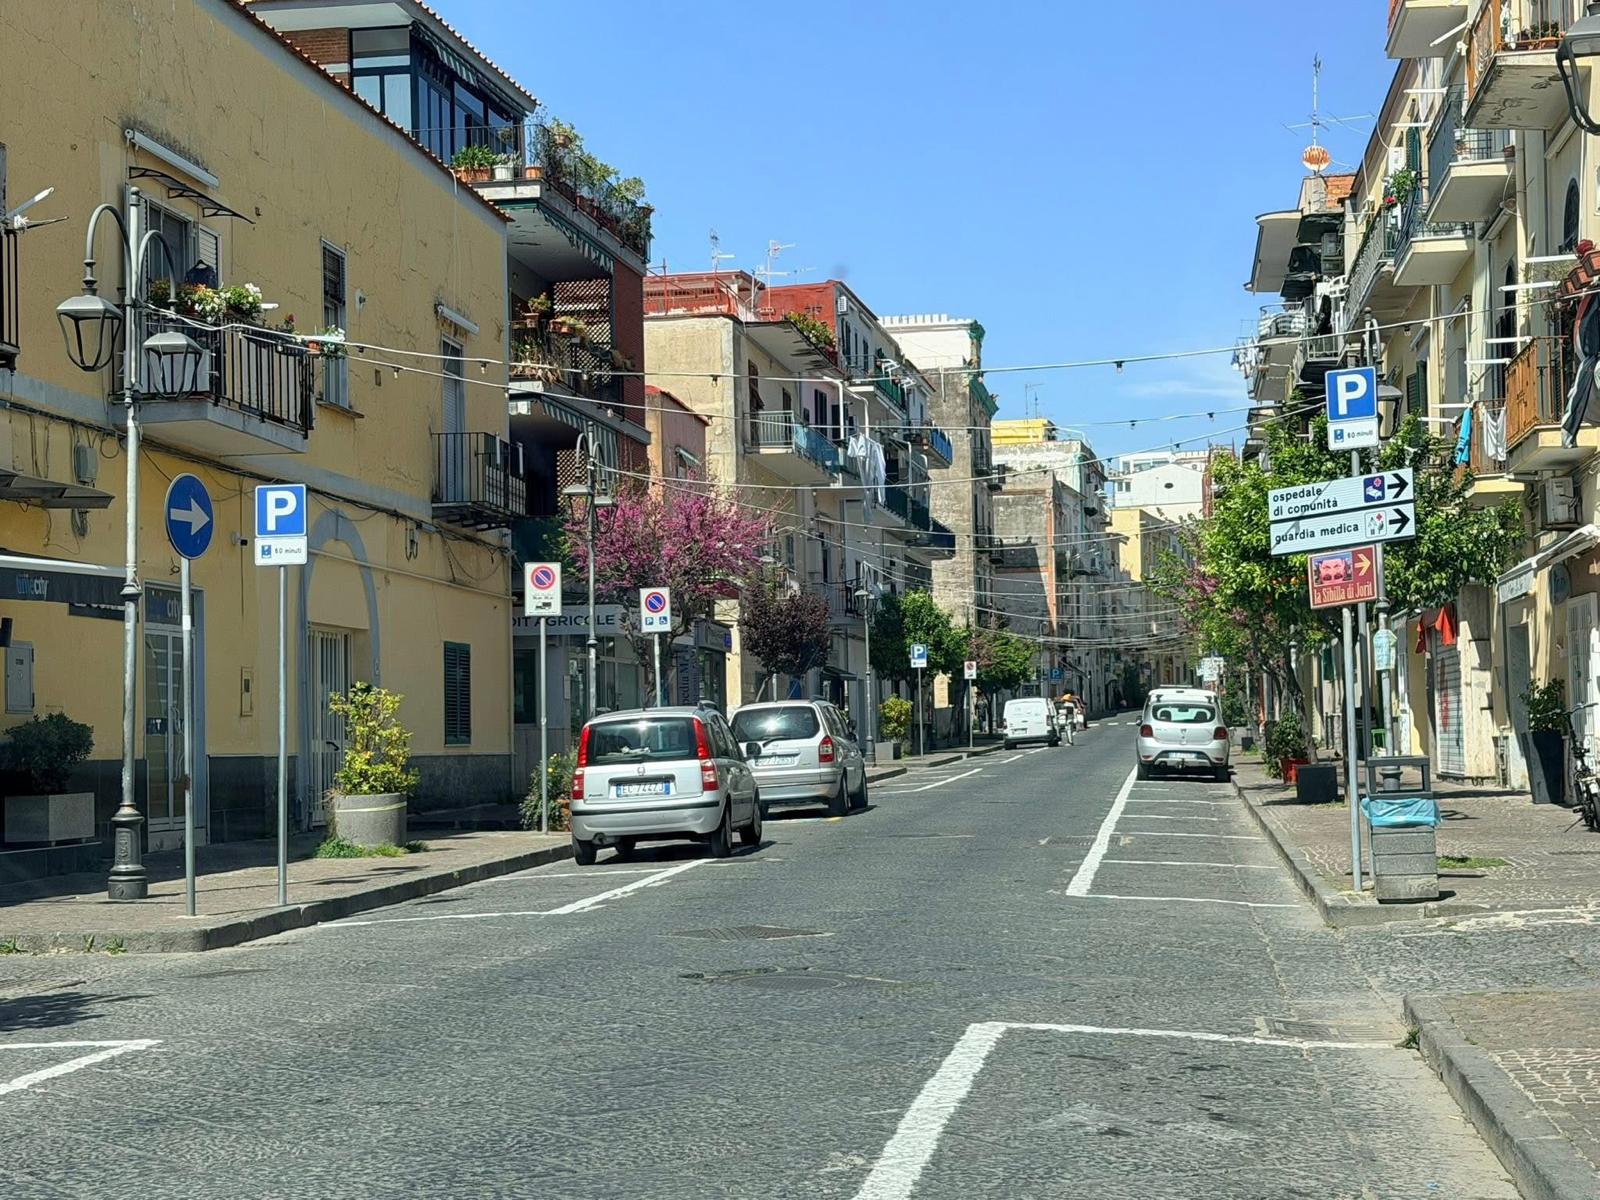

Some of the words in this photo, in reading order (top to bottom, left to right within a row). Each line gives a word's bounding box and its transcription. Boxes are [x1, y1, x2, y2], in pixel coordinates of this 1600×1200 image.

[1336, 374, 1368, 415] P
[1272, 486, 1322, 503] ospedale
[266, 490, 297, 531] P
[1273, 505, 1283, 517] di
[1287, 497, 1338, 514] comunità
[1275, 529, 1315, 544] guardia
[1320, 523, 1359, 537] medica
[1313, 589, 1322, 605] la
[1322, 586, 1346, 603] Sibilla
[1347, 583, 1354, 599] di
[914, 646, 924, 658] P
